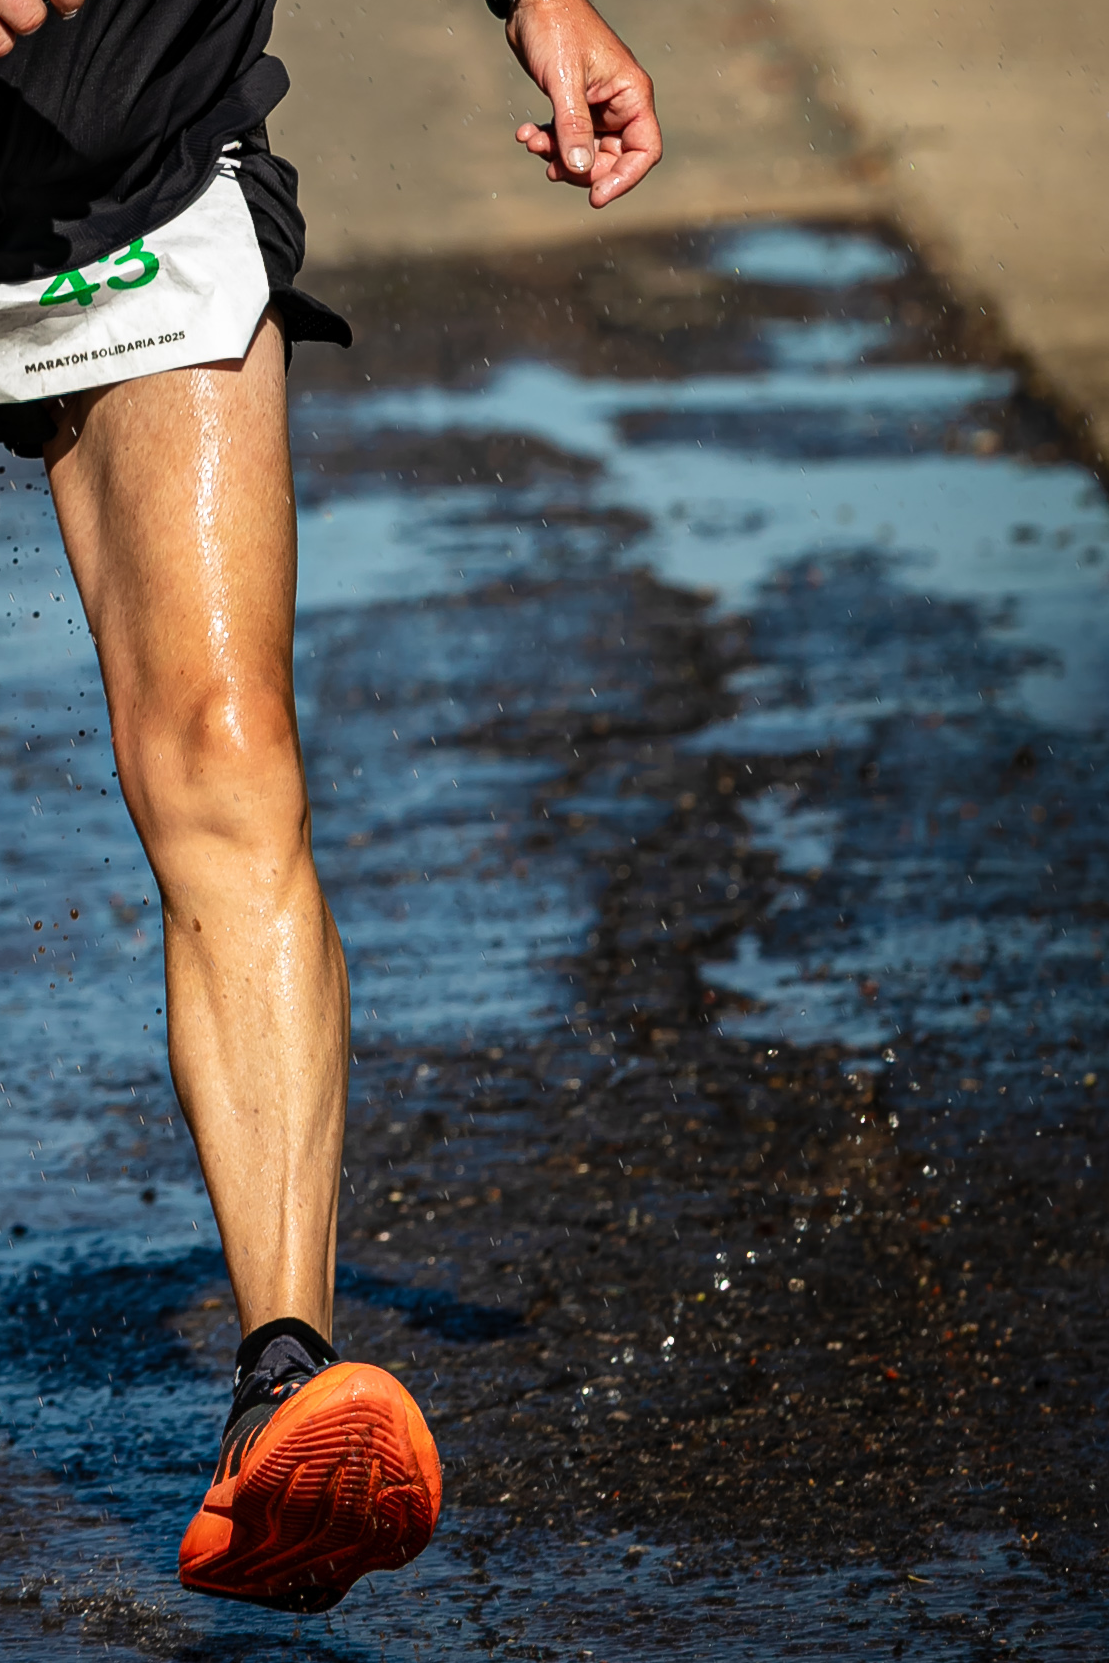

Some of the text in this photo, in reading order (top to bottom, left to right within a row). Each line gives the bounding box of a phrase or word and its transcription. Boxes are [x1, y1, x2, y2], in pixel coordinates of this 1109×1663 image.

[39, 238, 160, 306] 43
[91, 337, 156, 360] SOLIDARIA
[157, 330, 186, 345] 2025
